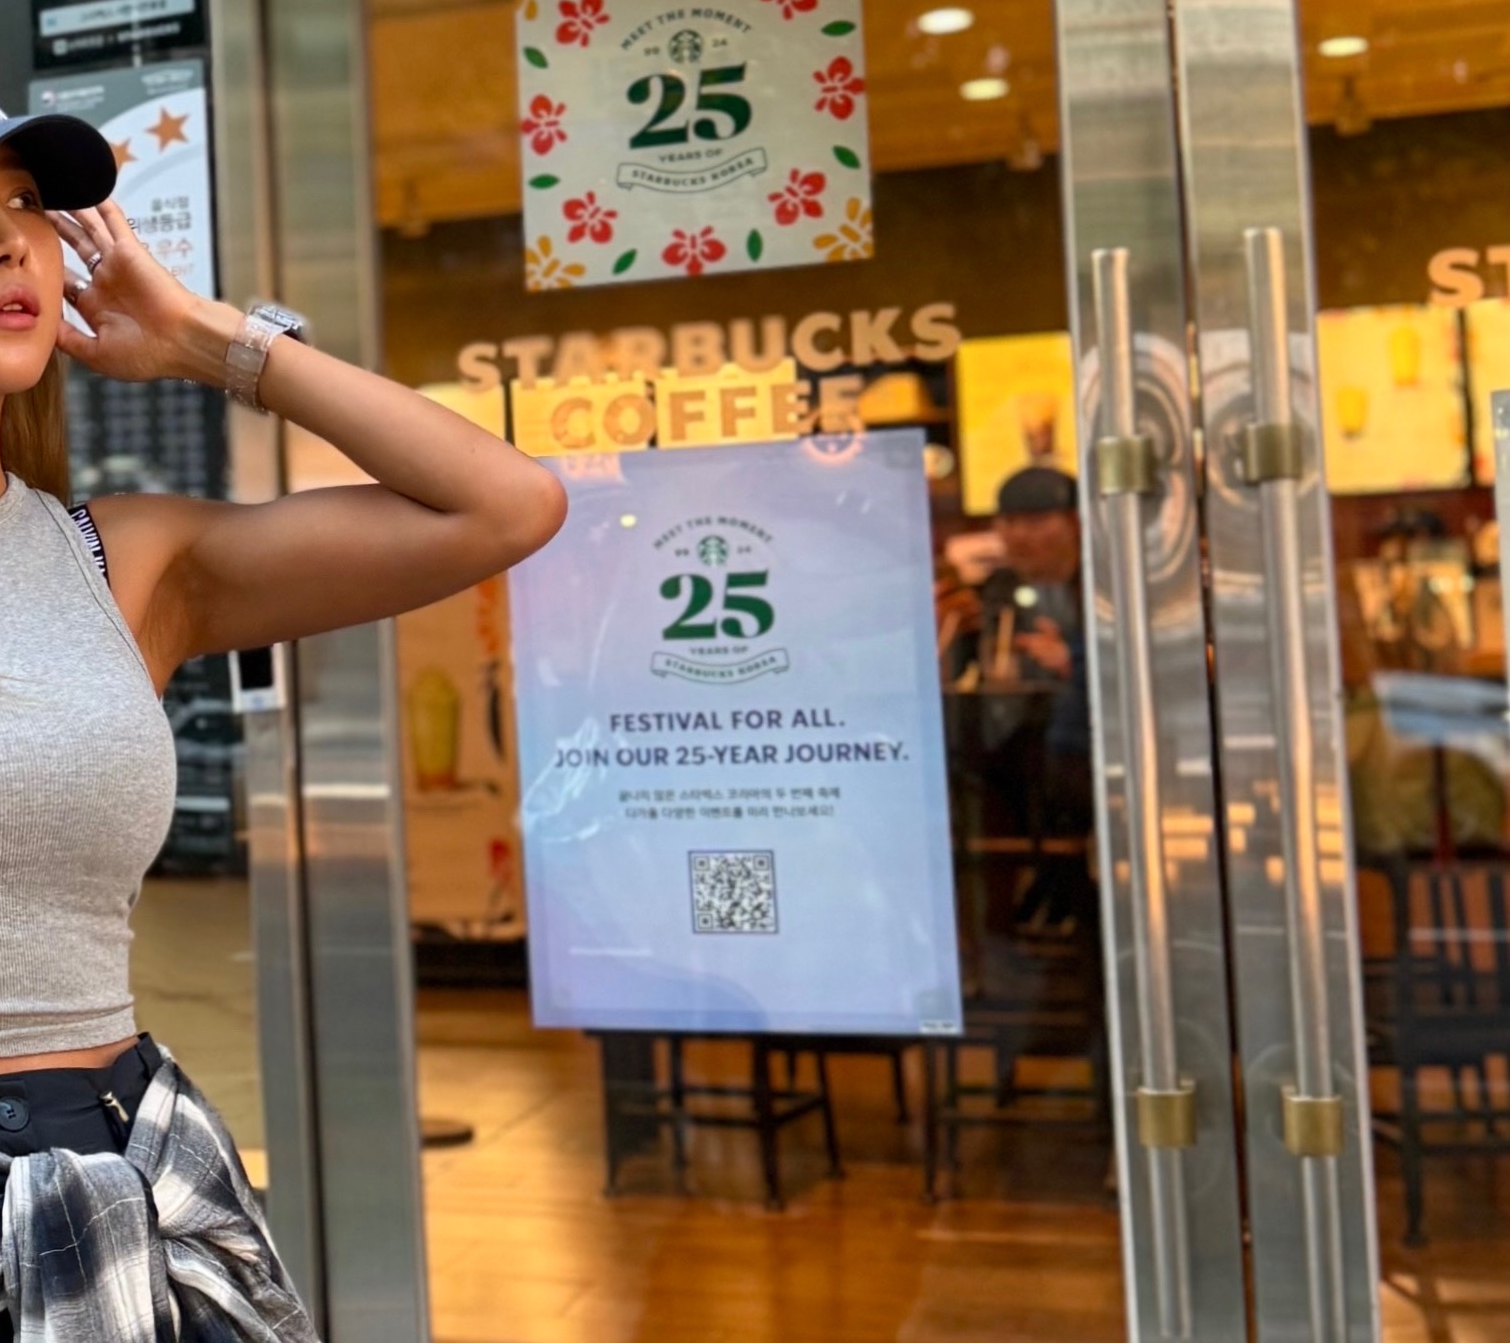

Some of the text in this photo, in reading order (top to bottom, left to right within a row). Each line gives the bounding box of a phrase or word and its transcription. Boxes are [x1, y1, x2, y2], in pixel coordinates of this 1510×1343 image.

[620, 7, 753, 51] MEET THE MOMENT
[626, 60, 753, 150] 25
[658, 147, 724, 163] YEARS OF
[632, 156, 754, 187] STARBUCKS KOREA
[457, 302, 963, 392] STARBUCKS
[549, 374, 866, 451] COFFEE
[653, 515, 773, 550] MEET THE MOMENT
[659, 569, 775, 641] 25
[690, 645, 730, 656] YEARS
[665, 655, 776, 679] STARBUCKS KOREA
[609, 708, 846, 734] FESTIVAL FOR ALL.
[555, 741, 910, 769] JOIN OUR 25-YEAR JOURNEY.
[679, 788, 724, 802] 스타벅스
